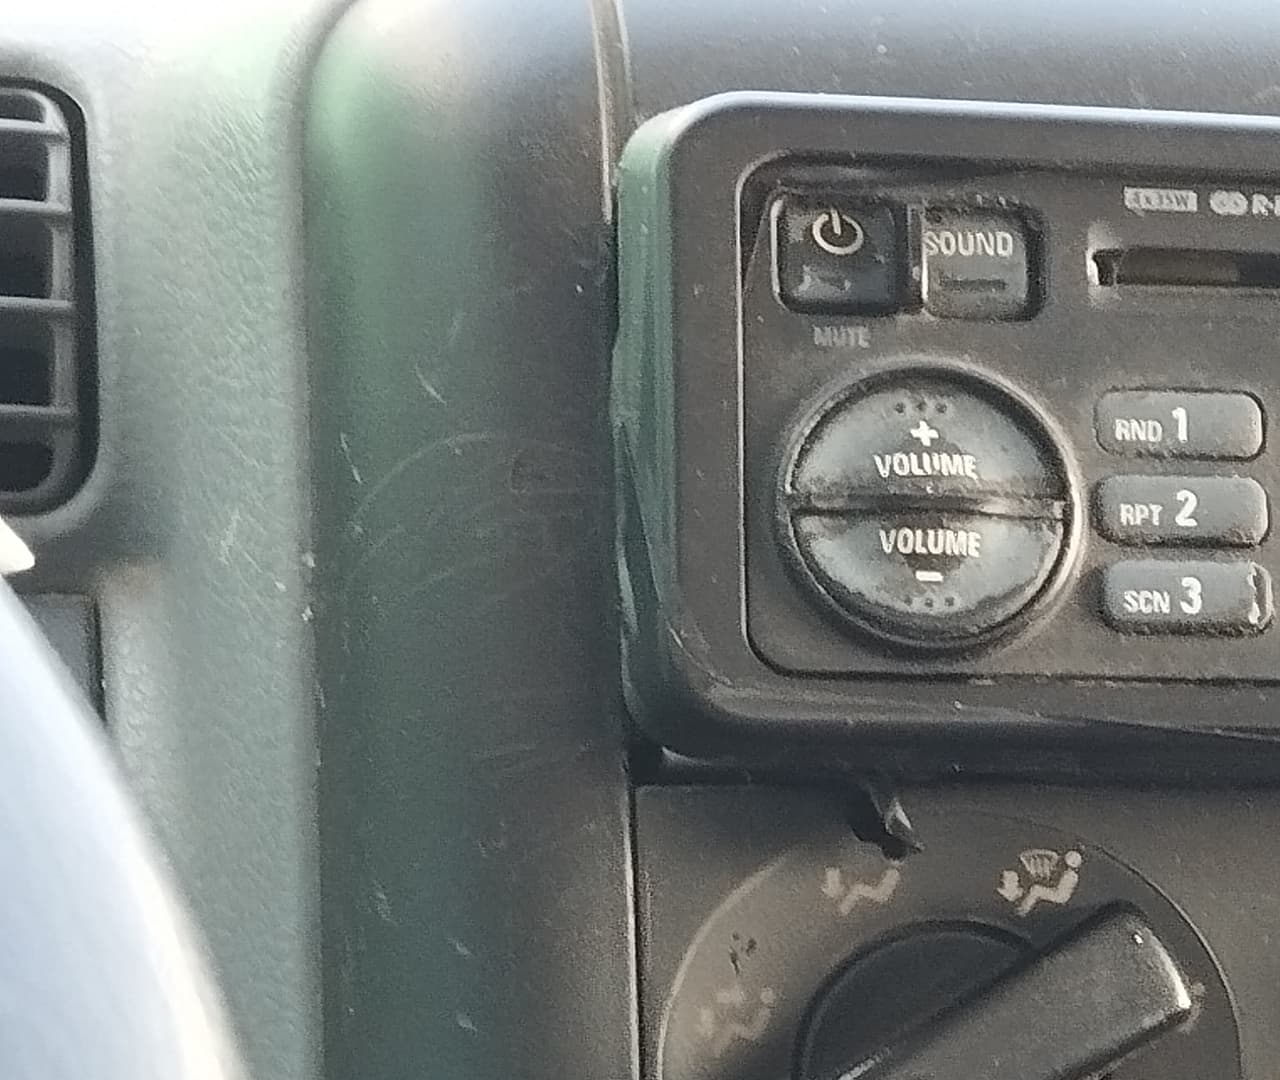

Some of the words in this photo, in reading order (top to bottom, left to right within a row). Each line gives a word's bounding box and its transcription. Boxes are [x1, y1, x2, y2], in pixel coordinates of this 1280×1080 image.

[925, 230, 1014, 257] SOUND
[1115, 418, 1163, 442] RND
[1171, 407, 1188, 441] 1
[873, 451, 979, 480] VOLUME
[1119, 502, 1163, 526] RPT
[1175, 488, 1198, 528] 2
[879, 527, 982, 558] VOLUME
[1124, 589, 1171, 615] SCN
[1180, 576, 1202, 616] 3
